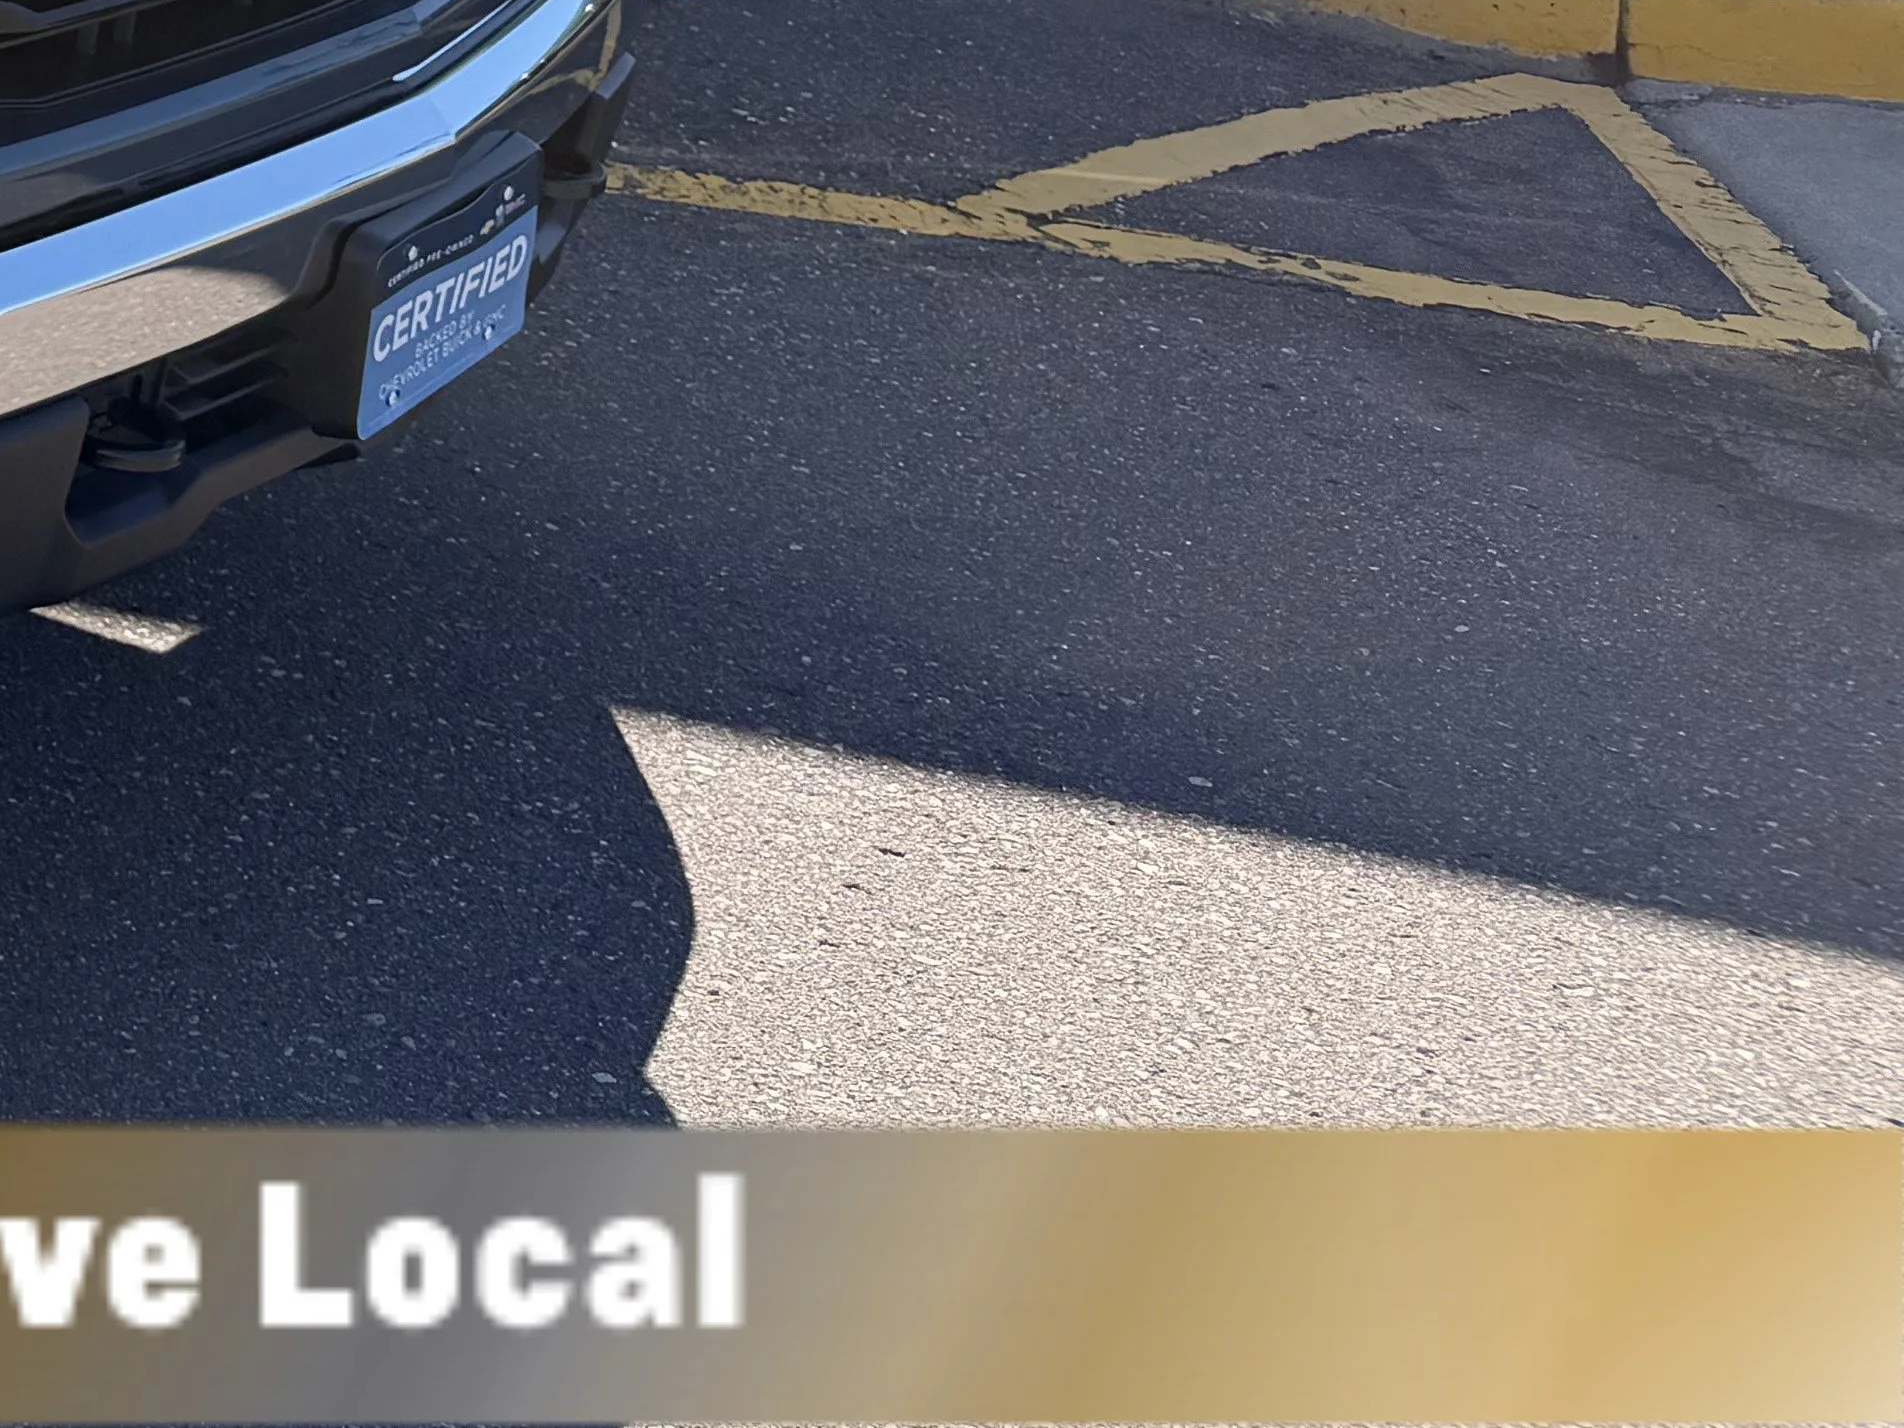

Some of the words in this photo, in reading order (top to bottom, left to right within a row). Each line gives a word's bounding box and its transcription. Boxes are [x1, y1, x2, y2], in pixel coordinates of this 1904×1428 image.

[372, 234, 529, 362] CERTIFIED
[415, 320, 458, 359] BACKED
[458, 309, 476, 330] BY
[442, 327, 473, 358] BUICK
